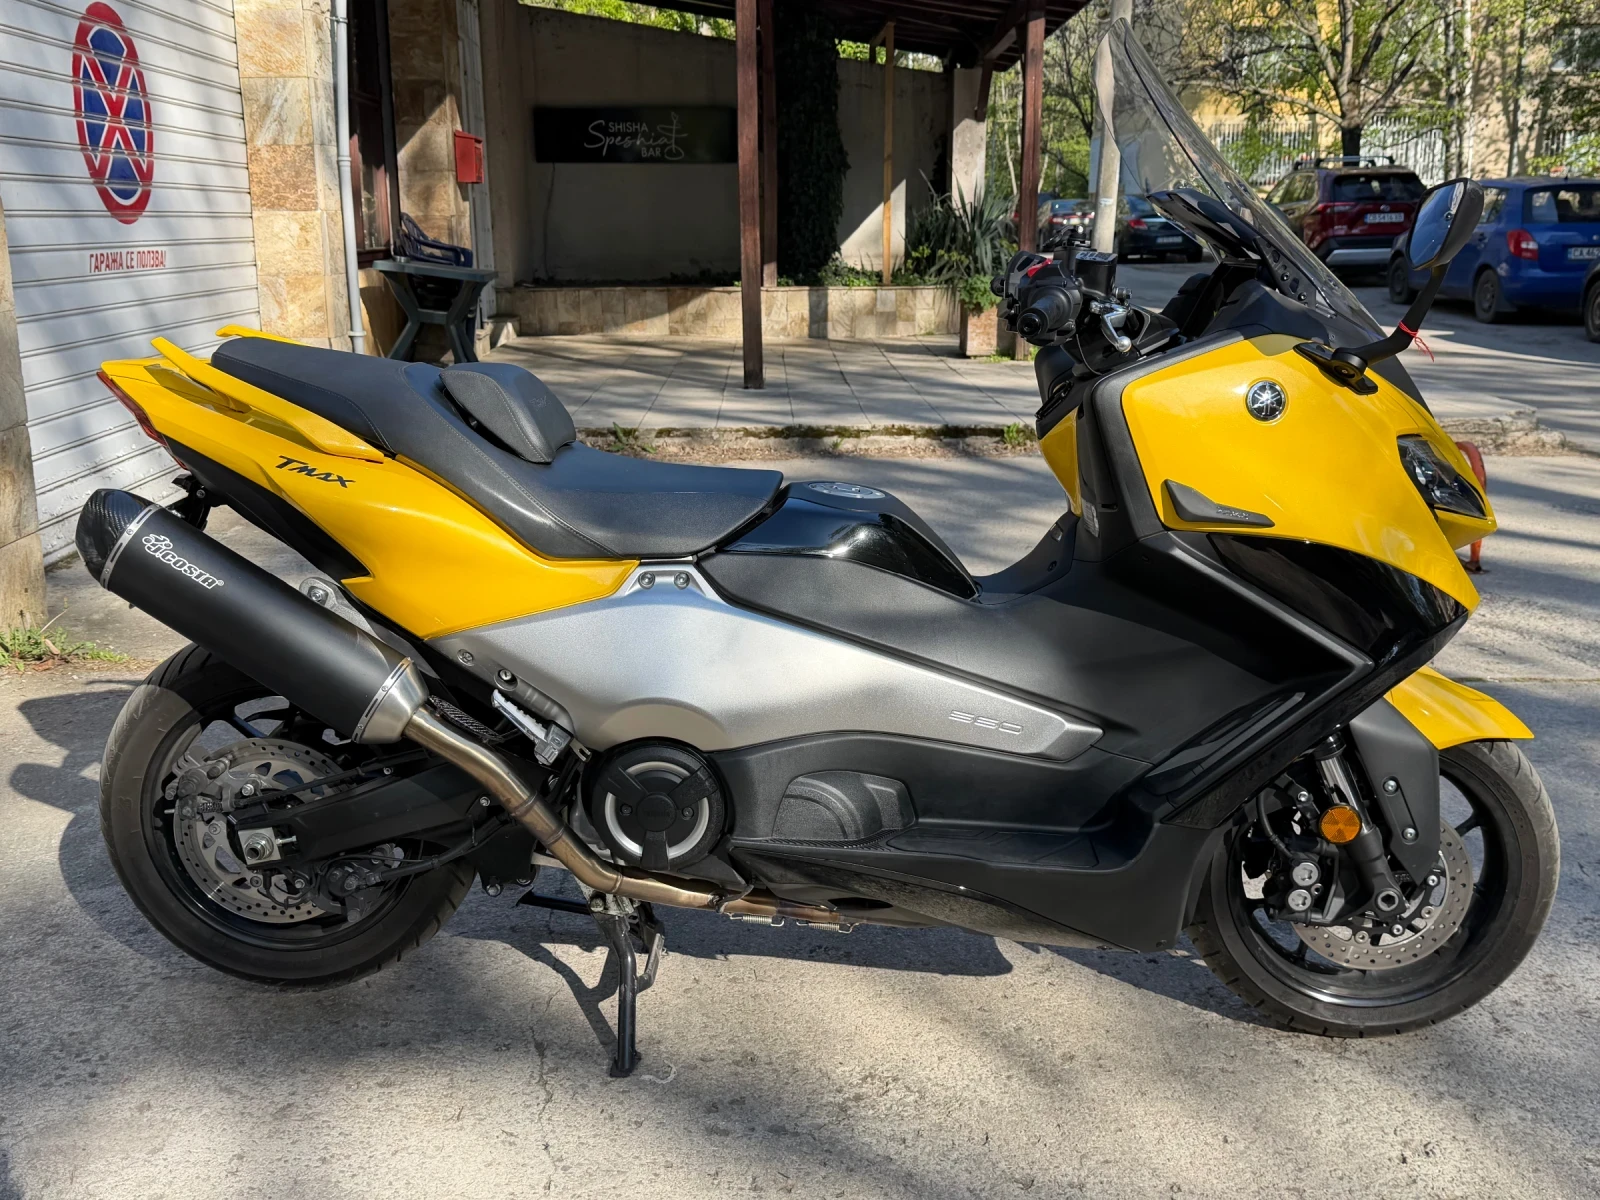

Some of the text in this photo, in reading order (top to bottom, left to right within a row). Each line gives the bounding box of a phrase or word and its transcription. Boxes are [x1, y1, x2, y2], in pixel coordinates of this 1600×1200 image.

[608, 122, 649, 133] SHISHA
[641, 147, 661, 157] BAR
[89, 250, 167, 273] ГАРАЖА СЕ ПОЛЗВА!
